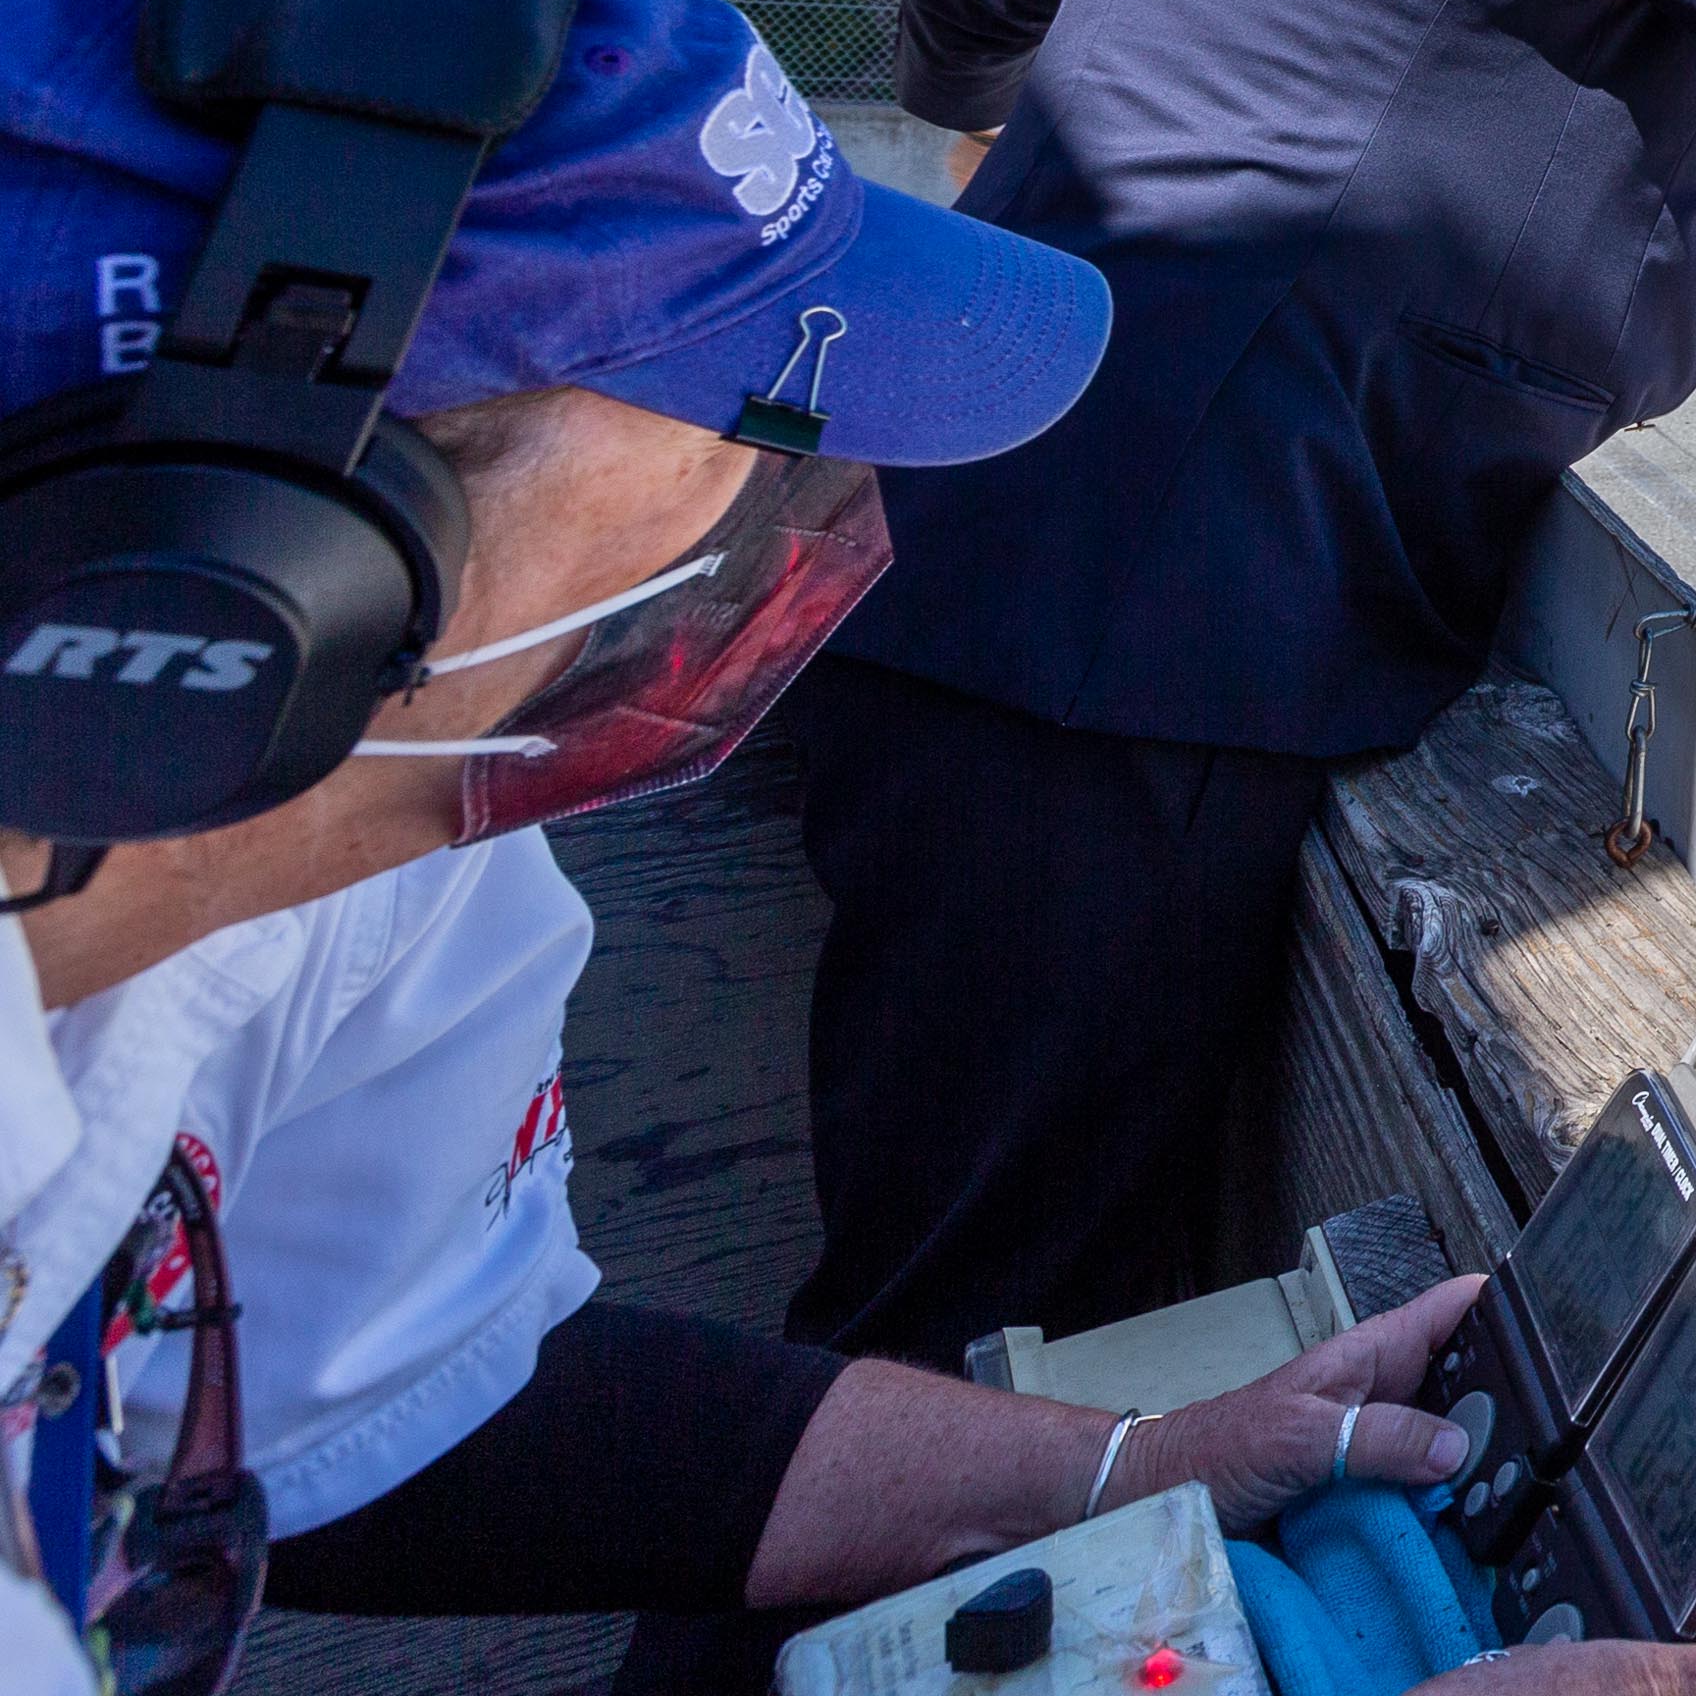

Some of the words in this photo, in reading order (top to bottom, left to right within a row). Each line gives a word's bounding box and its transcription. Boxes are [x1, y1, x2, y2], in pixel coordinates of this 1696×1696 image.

[760, 177, 824, 246] Sports
[4, 623, 273, 691] RTS
[1651, 1122, 1668, 1149] DUAL
[1661, 1140, 1680, 1172] TIMER
[1674, 1168, 1695, 1202] CLOCK
